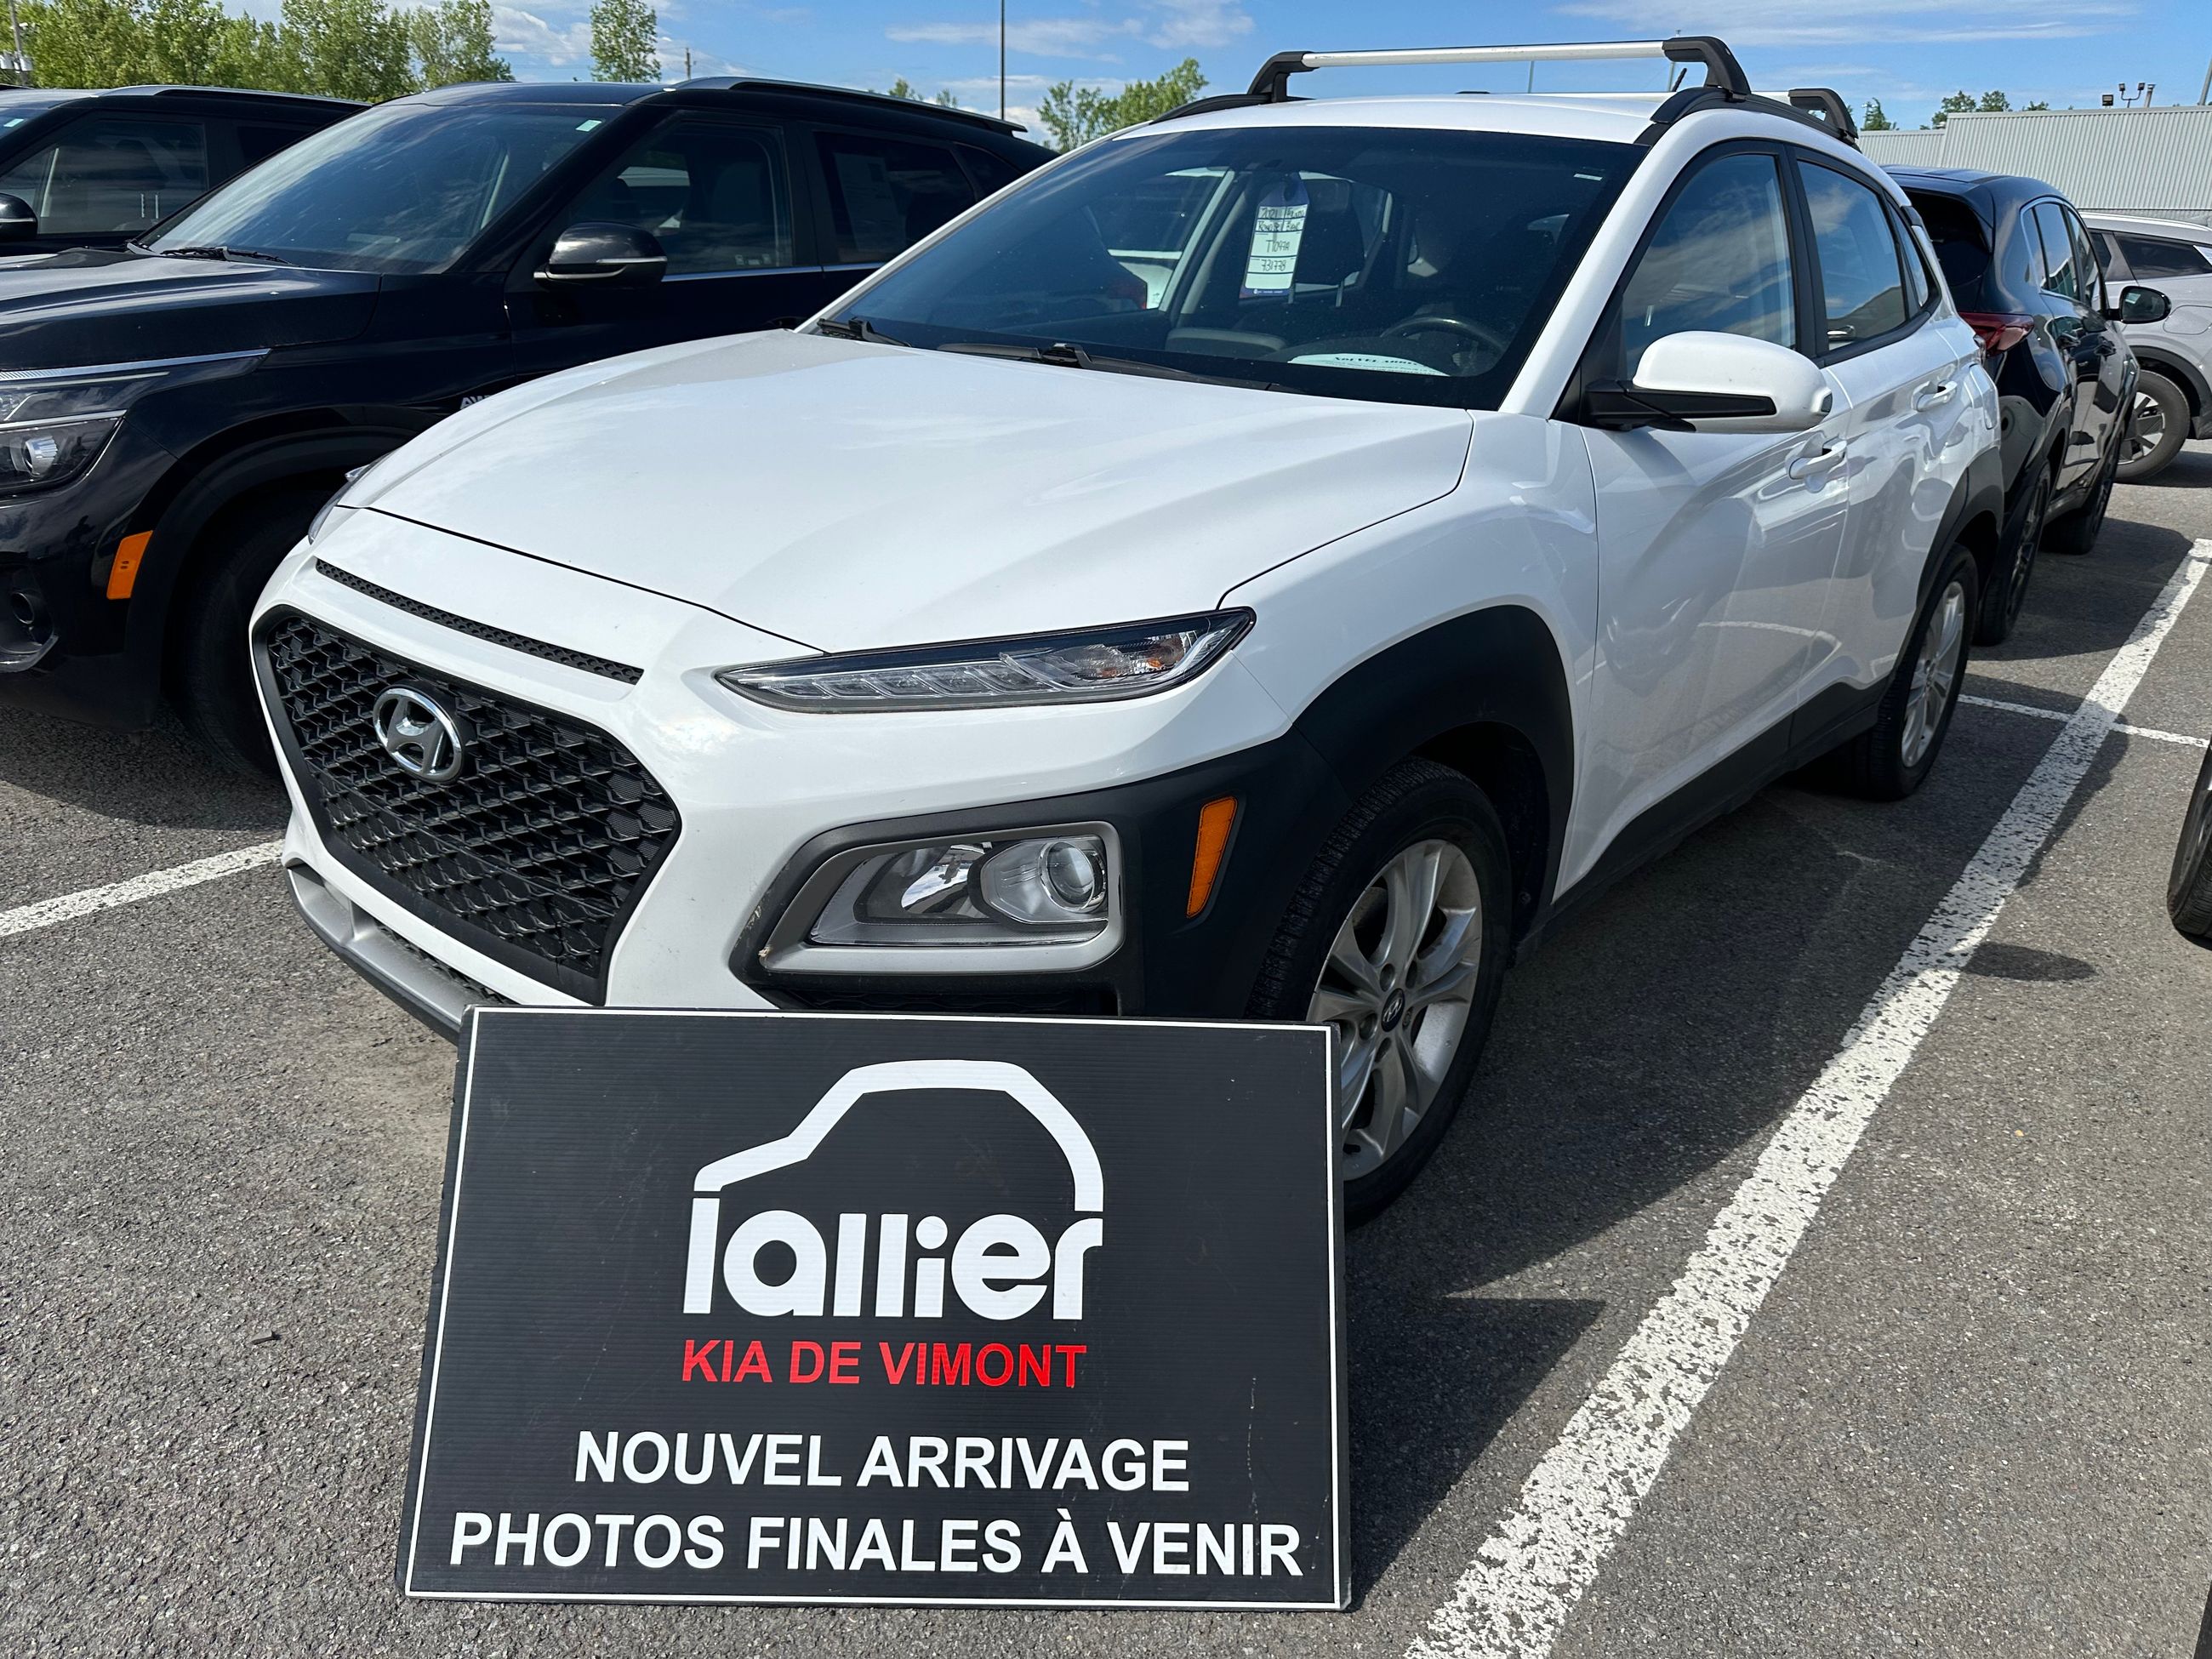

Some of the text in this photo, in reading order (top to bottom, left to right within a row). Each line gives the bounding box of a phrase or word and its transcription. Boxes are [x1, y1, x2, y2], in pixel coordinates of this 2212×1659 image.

[460, 394, 493, 410] AW
[682, 1340, 1087, 1387] KIA DE VIMONT
[575, 1431, 1189, 1491] NOUVEL ARRIVAGE
[450, 1508, 1303, 1576] PHOTOS FINALES À VENIR
